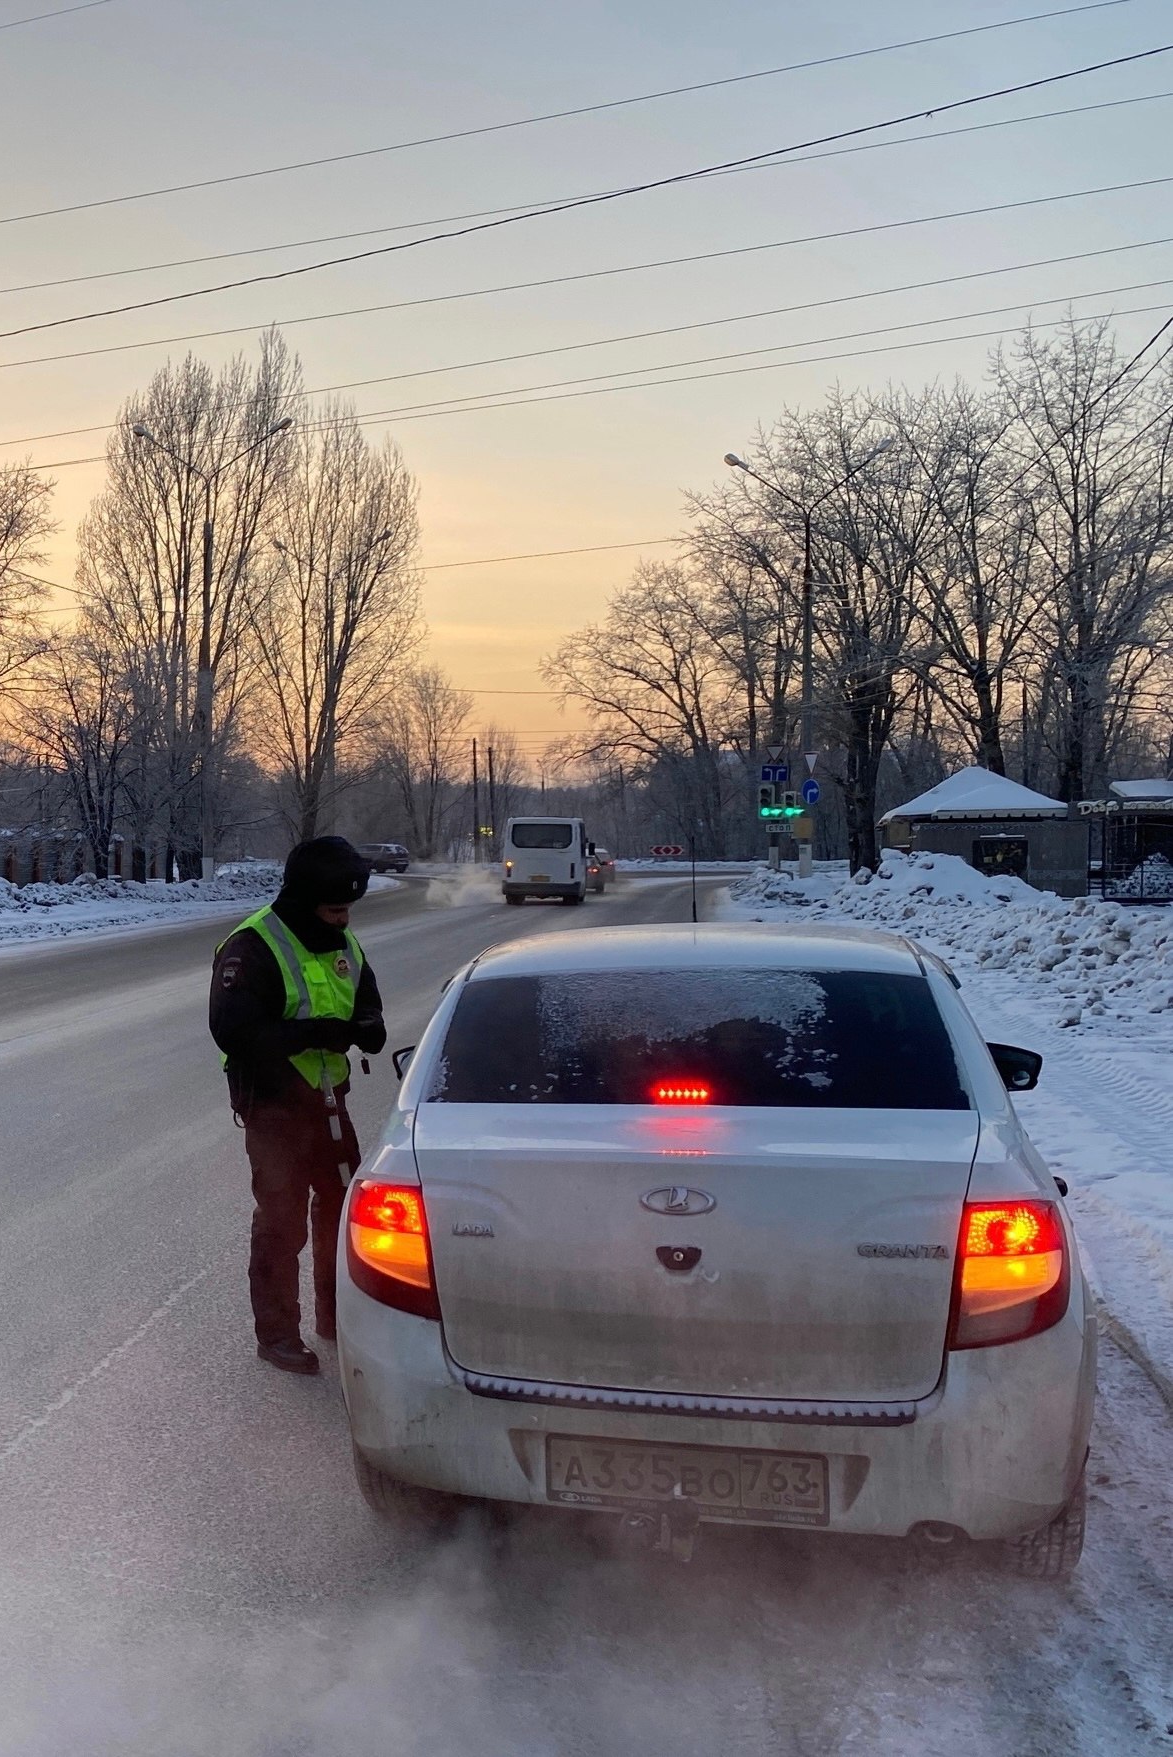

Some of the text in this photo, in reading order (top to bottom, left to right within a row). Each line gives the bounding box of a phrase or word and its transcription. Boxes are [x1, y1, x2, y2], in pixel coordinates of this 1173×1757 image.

[450, 1223, 495, 1238] LADA
[857, 1243, 950, 1259] GRANTA
[743, 1458, 812, 1495] 763
[760, 1491, 793, 1506] RUS
